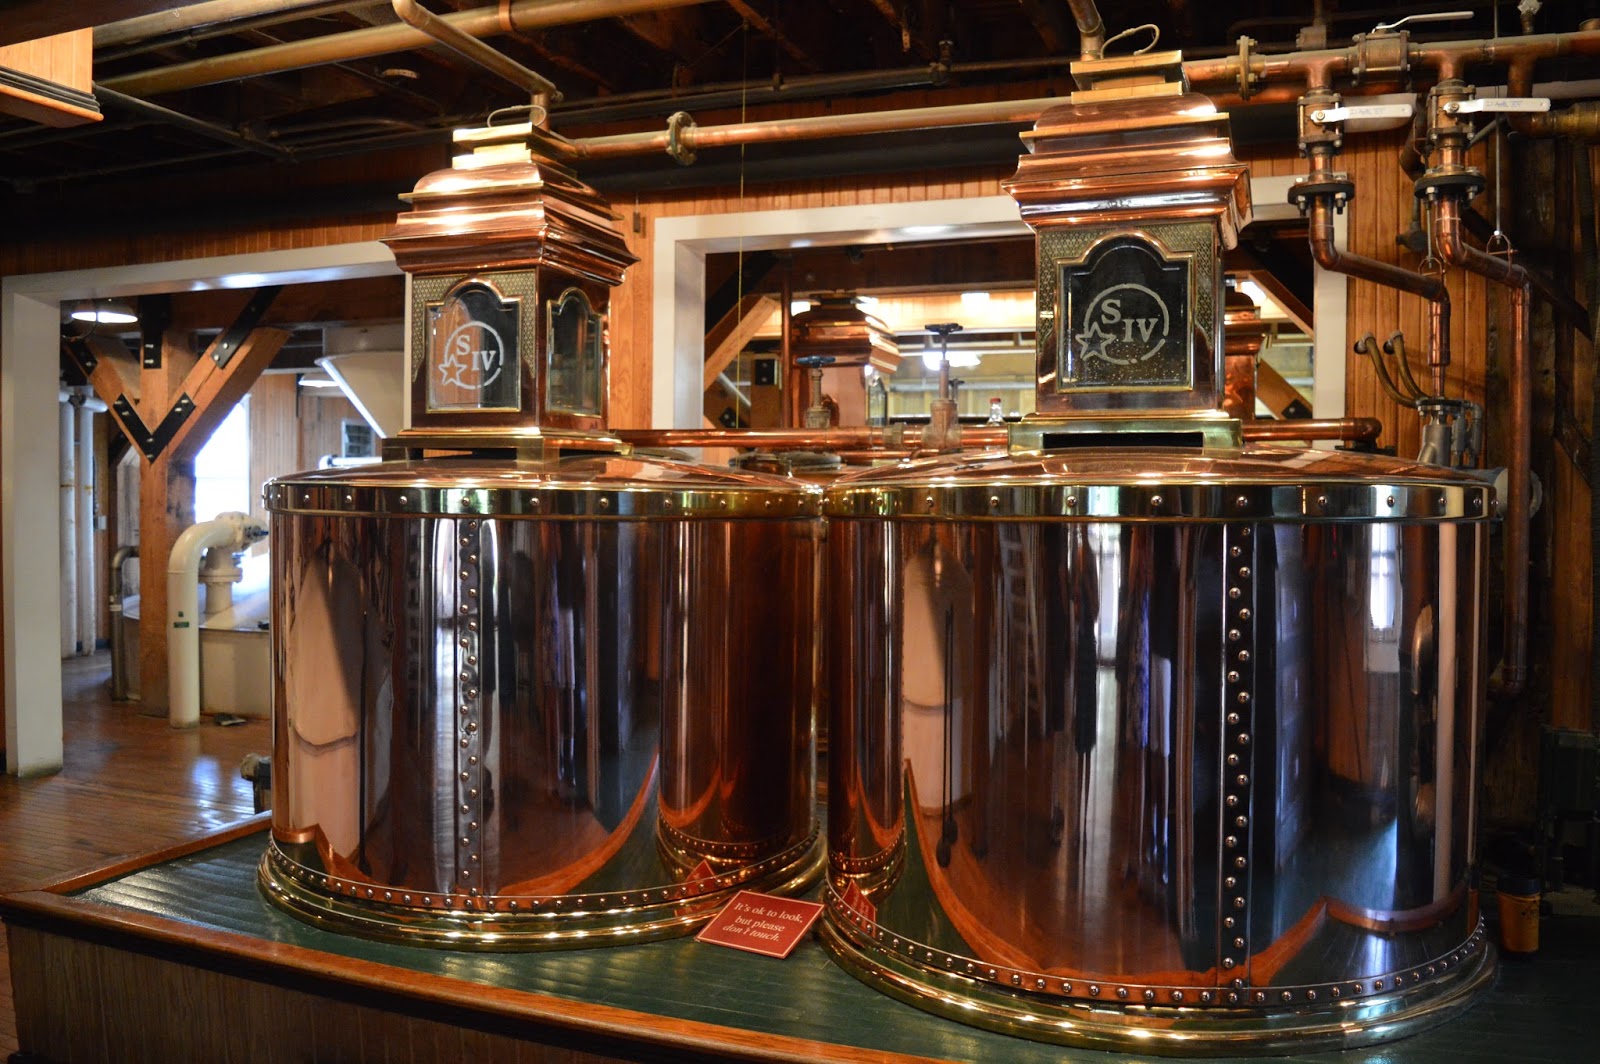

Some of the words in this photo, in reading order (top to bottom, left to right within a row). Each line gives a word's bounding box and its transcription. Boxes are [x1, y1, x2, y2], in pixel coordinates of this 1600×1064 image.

[734, 902, 751, 912] It's
[752, 906, 765, 915] ok
[766, 909, 778, 917] to
[734, 915, 751, 926] but
[752, 918, 785, 931] please
[722, 925, 750, 935] don't
[750, 930, 779, 941] touch.
